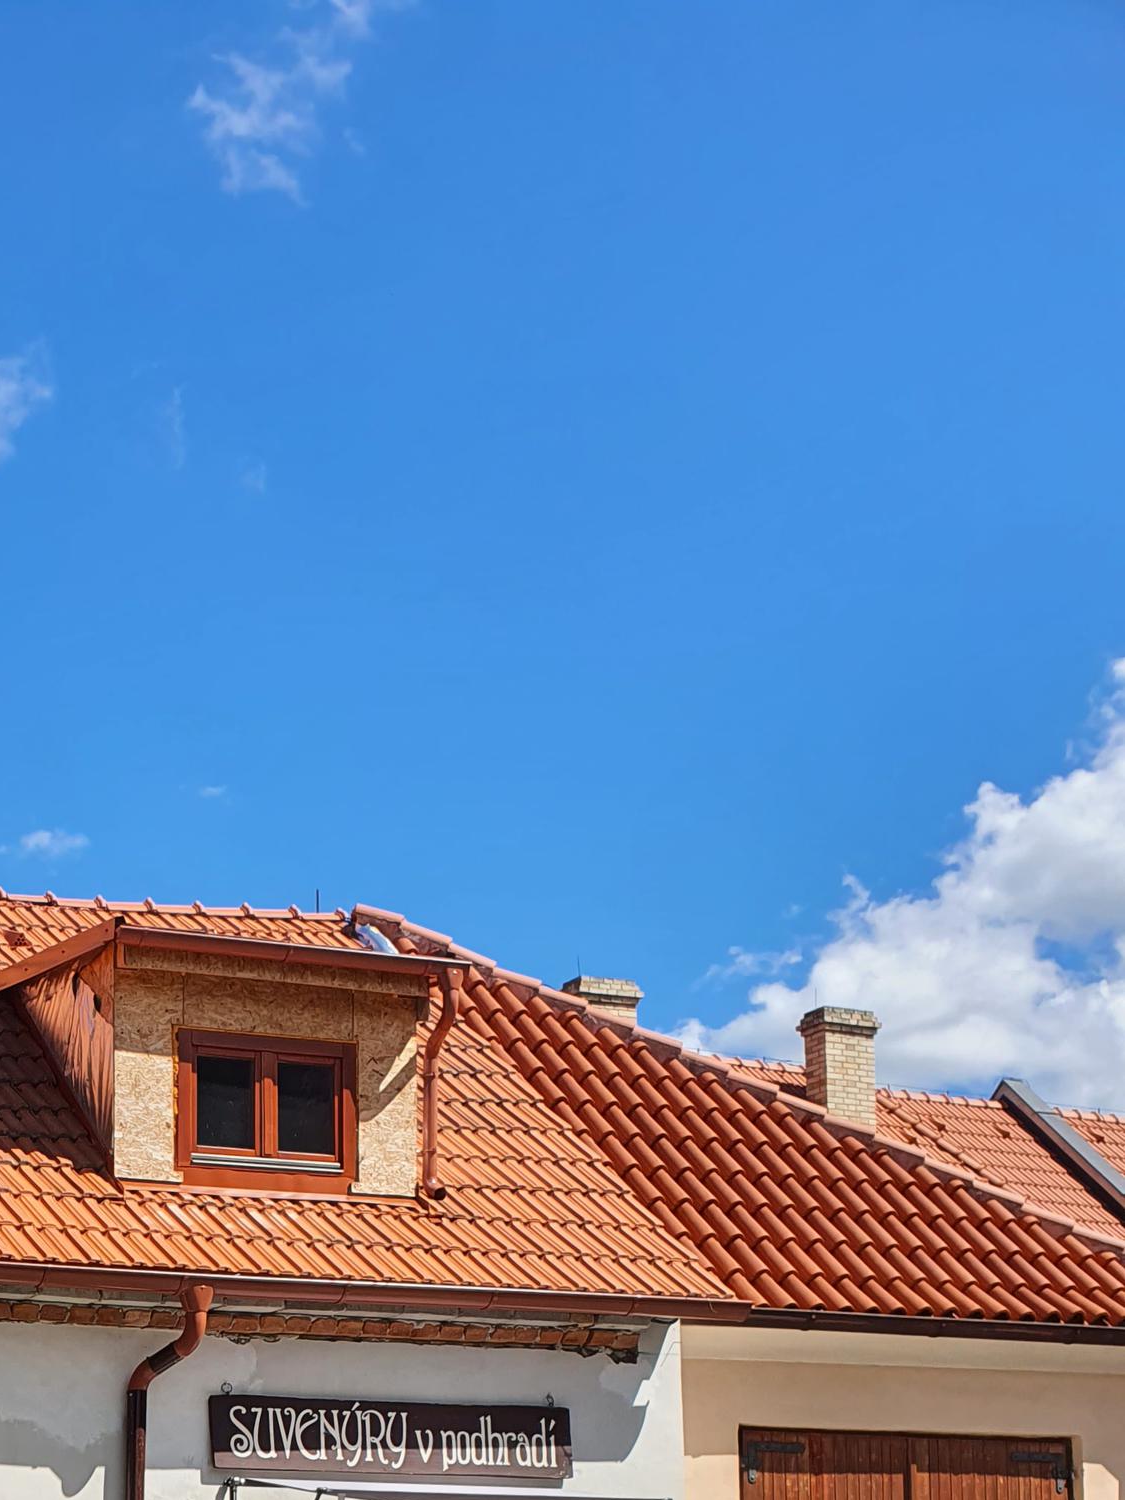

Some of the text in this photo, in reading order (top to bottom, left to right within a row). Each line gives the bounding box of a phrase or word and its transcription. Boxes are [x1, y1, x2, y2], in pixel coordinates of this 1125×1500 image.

[229, 1402, 558, 1472] SUVENÝRY v podhradí
